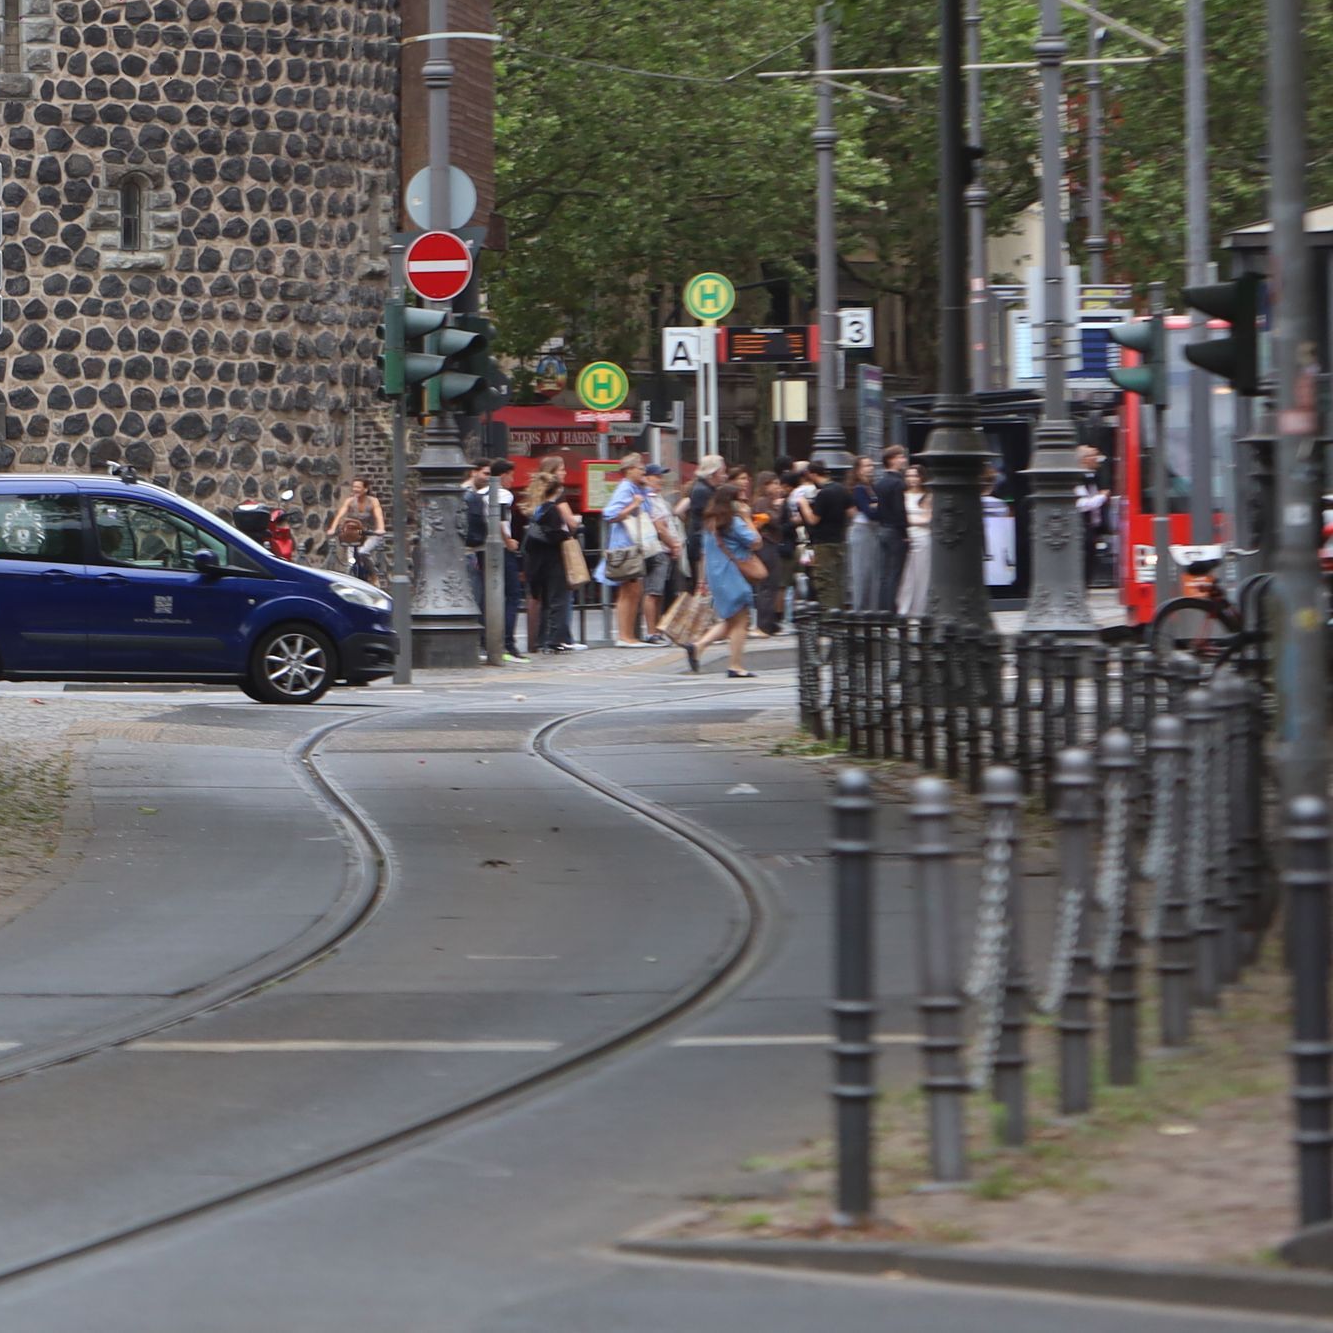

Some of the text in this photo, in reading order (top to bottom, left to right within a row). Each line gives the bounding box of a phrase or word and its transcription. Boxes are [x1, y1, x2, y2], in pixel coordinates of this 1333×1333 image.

[699, 284, 721, 309] H
[847, 320, 866, 344] 3
[670, 340, 693, 367] A
[592, 373, 615, 400] H
